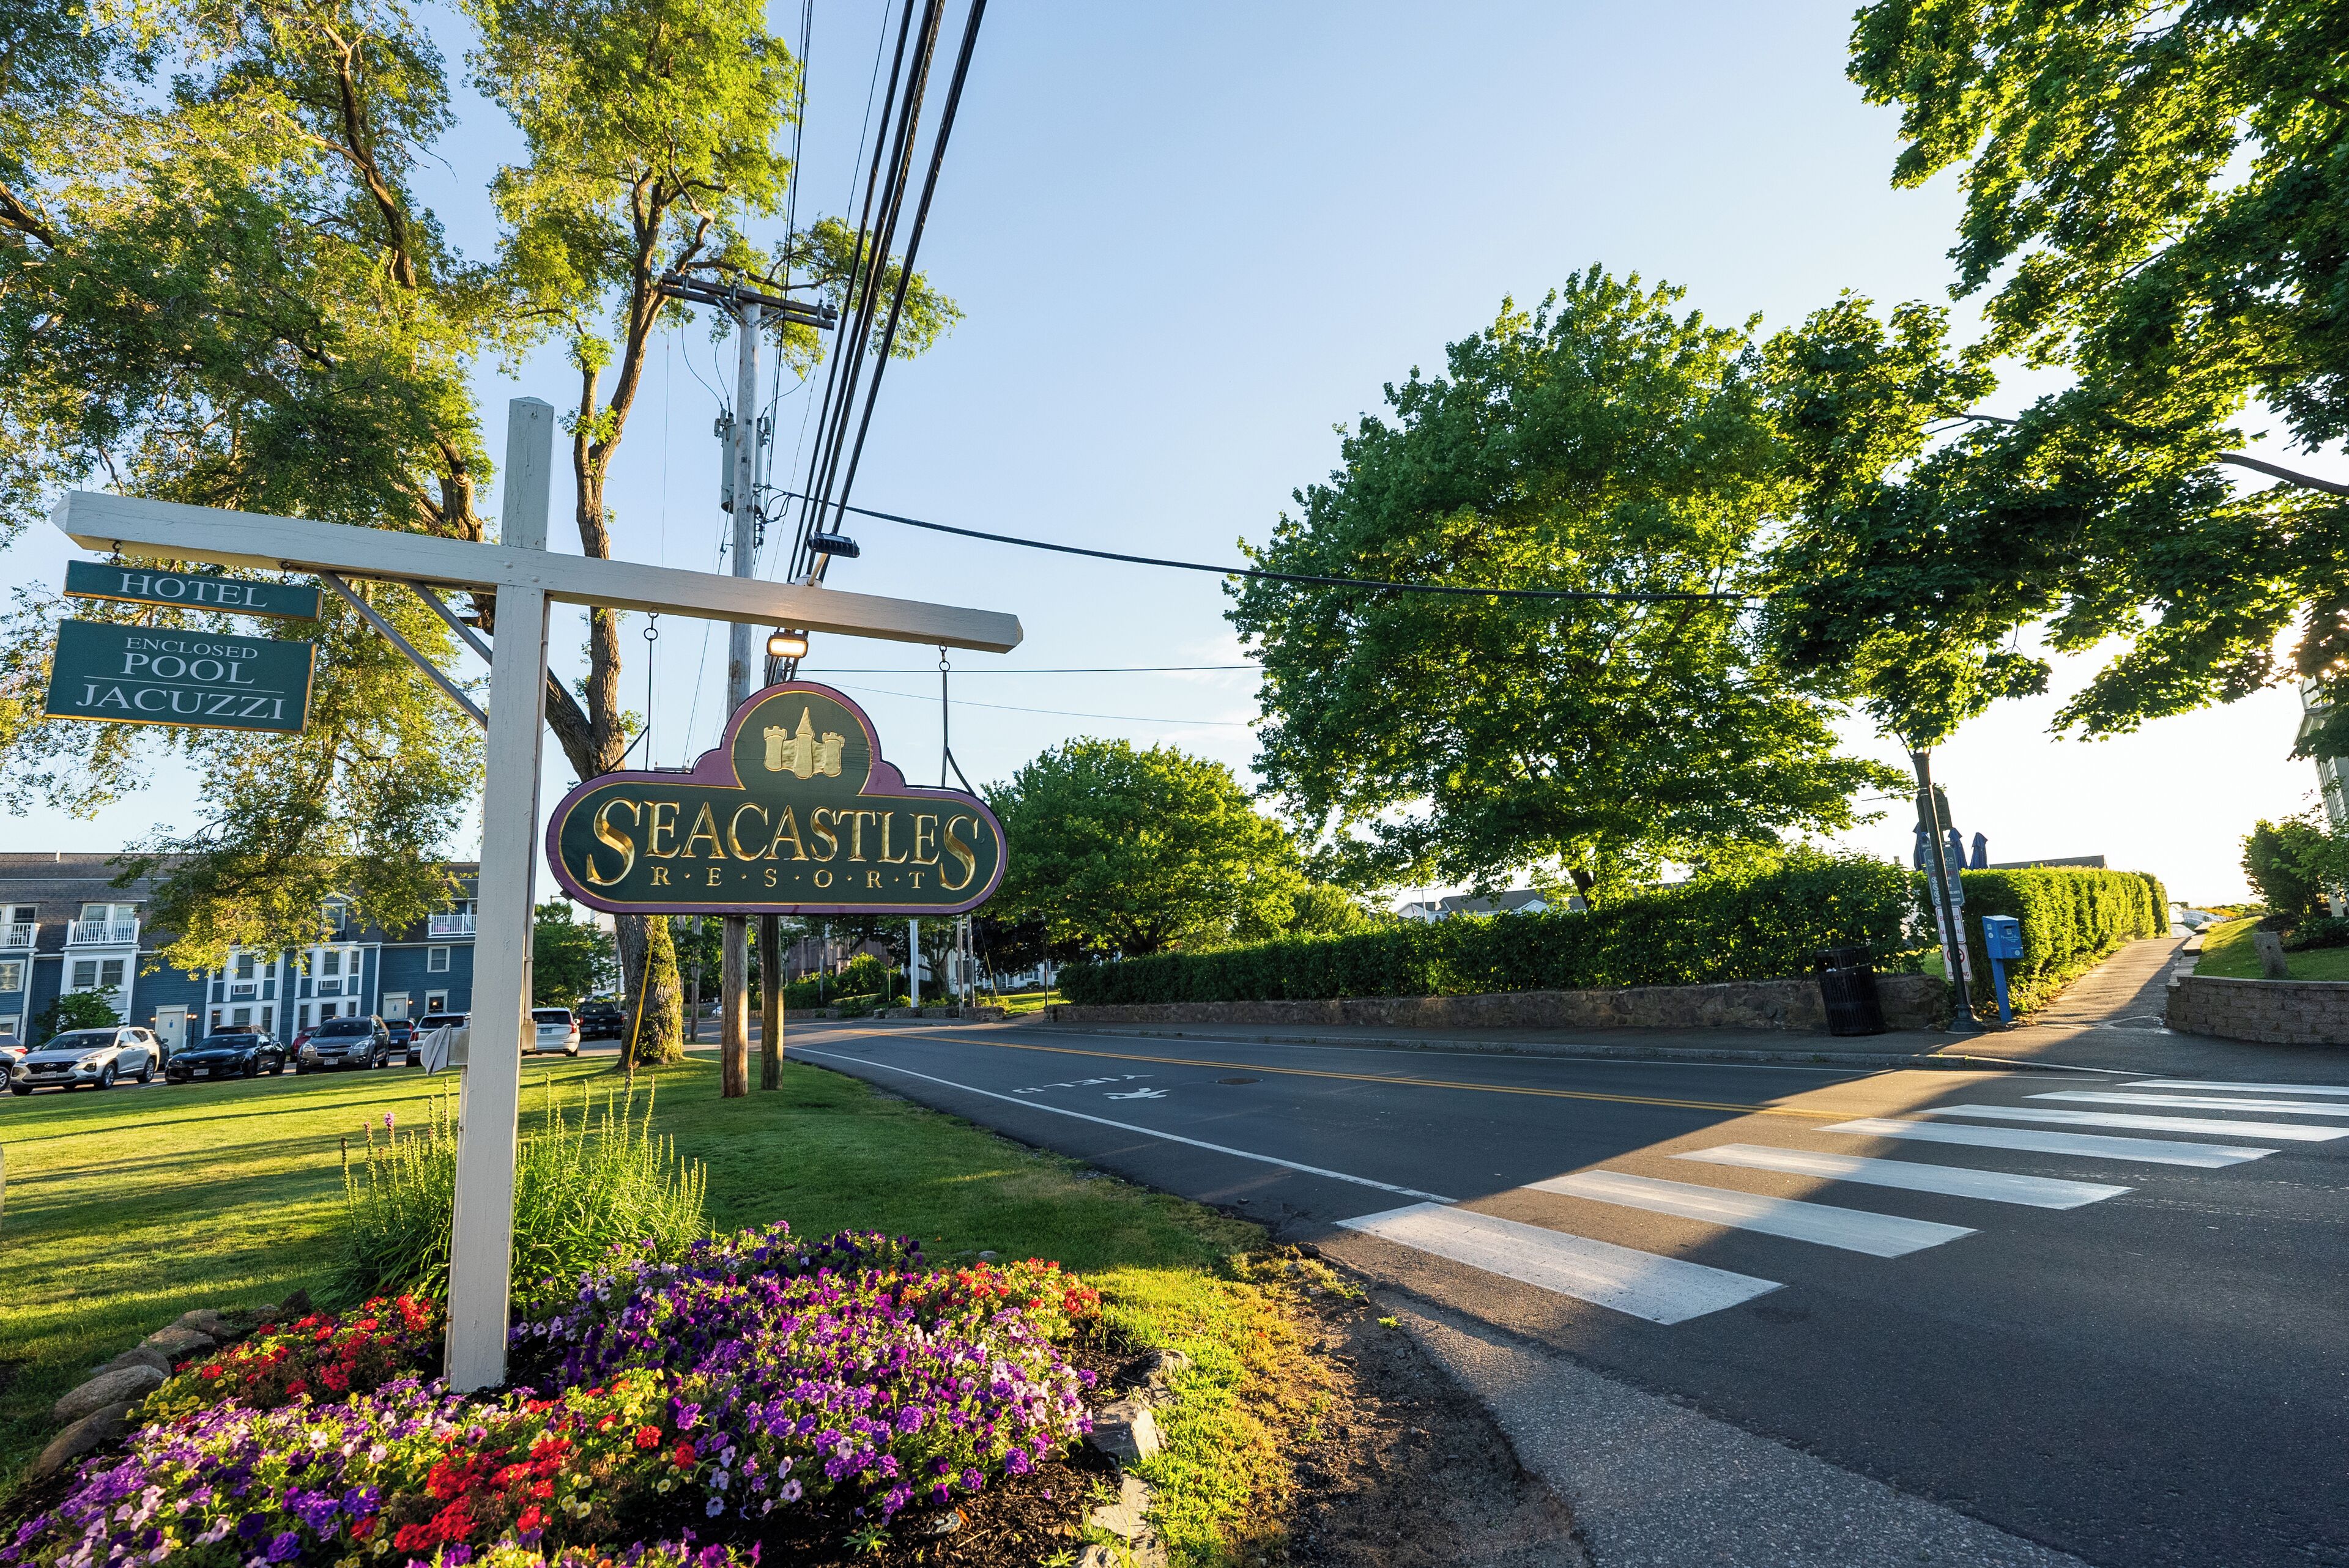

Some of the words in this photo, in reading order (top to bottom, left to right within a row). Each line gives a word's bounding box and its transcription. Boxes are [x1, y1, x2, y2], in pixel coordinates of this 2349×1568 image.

[117, 572, 268, 608] HOTEL
[126, 637, 258, 659] ENCLOSED
[120, 652, 254, 684] POOL
[75, 683, 287, 720] JACUZZI
[586, 797, 979, 891] SEACASTLES
